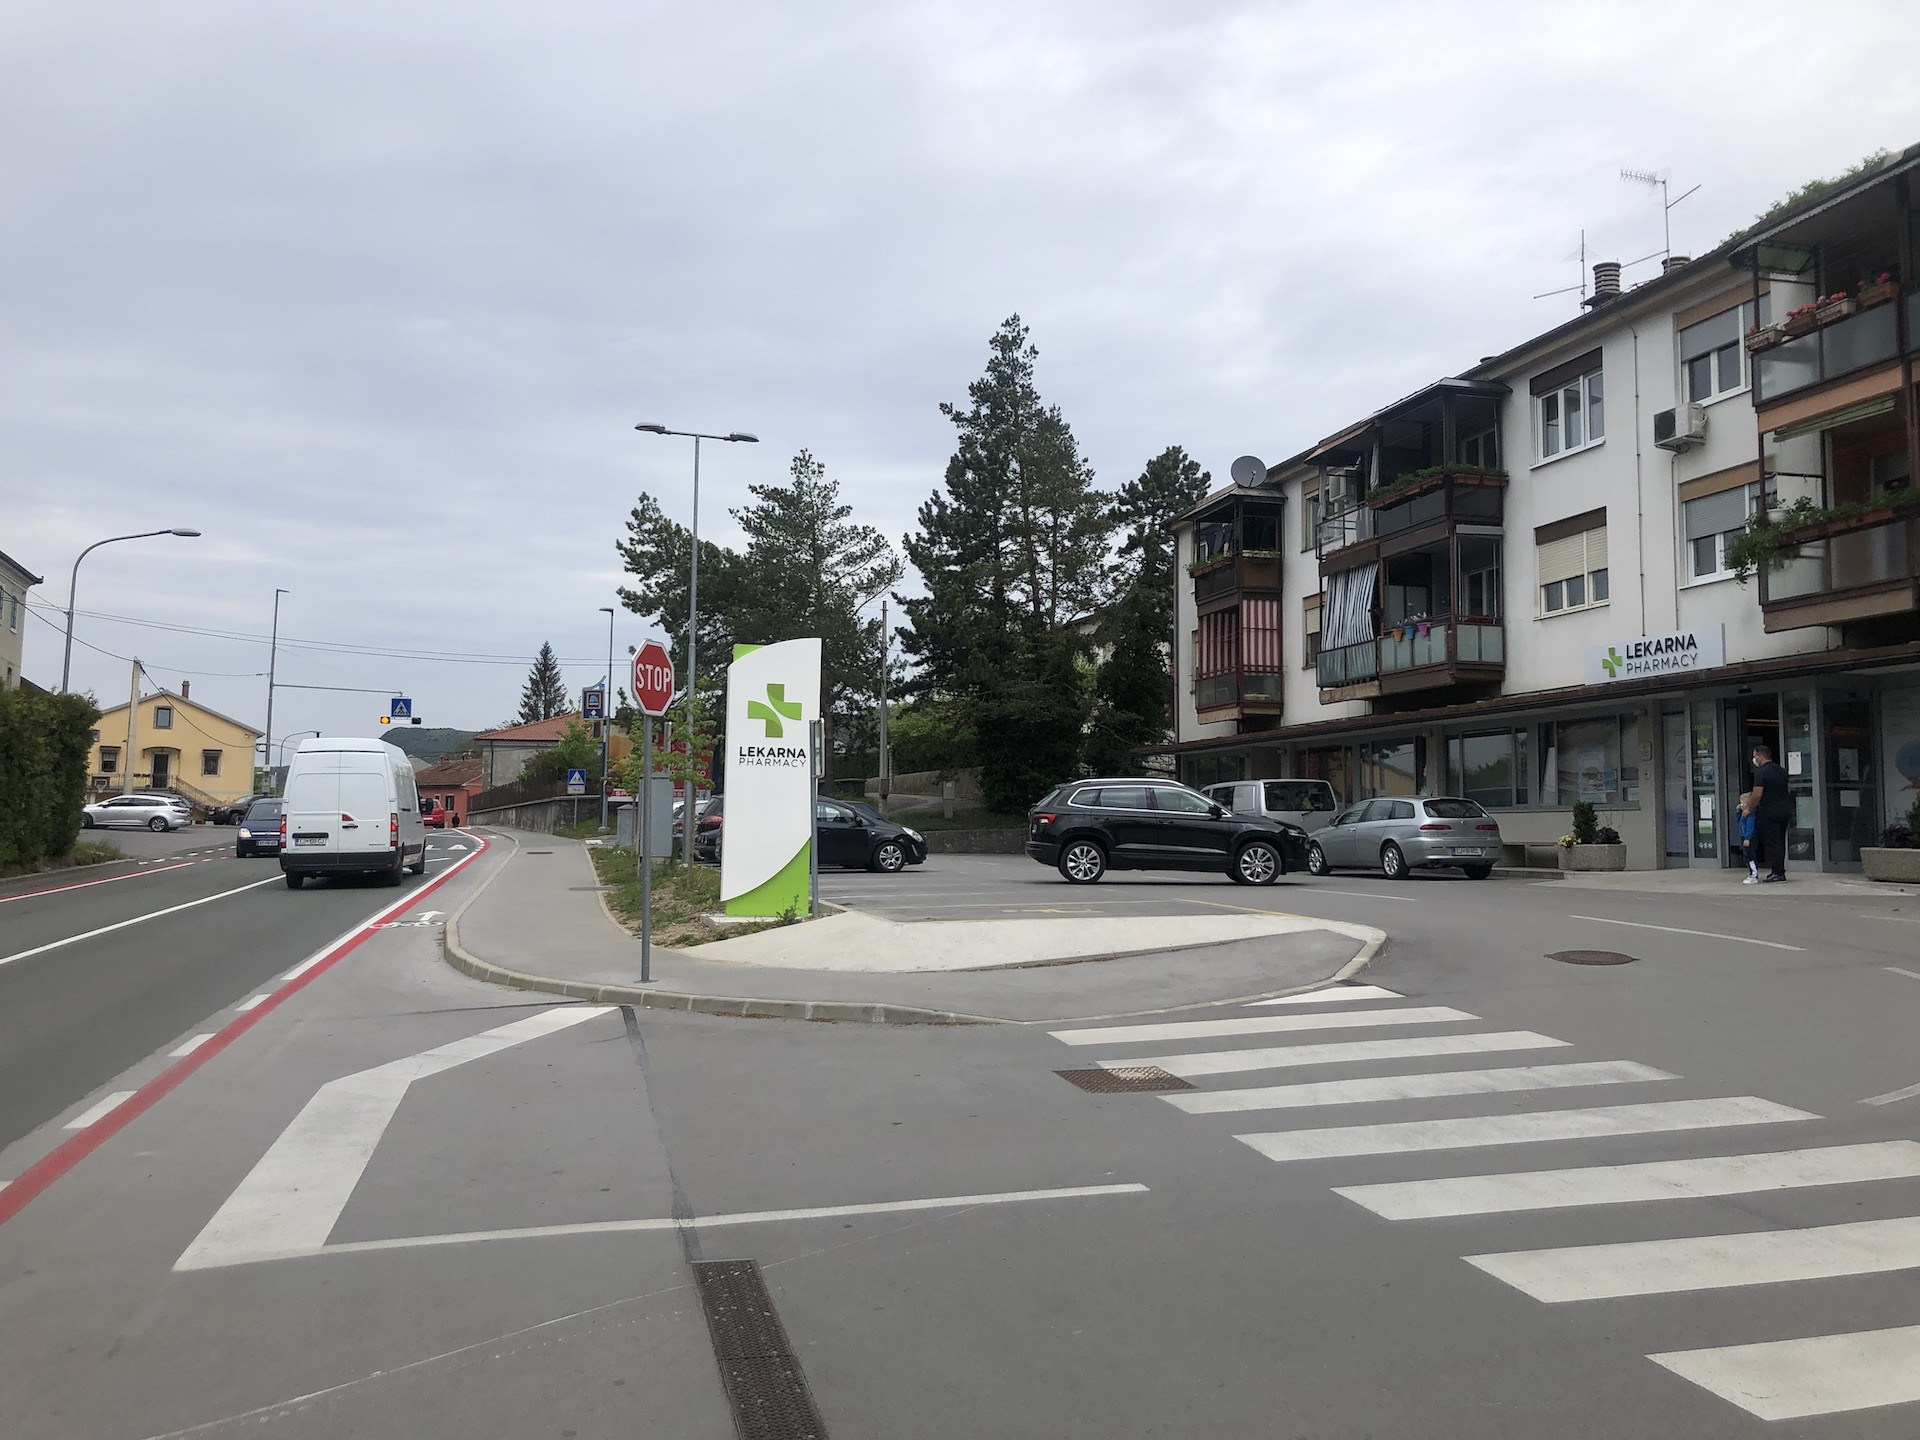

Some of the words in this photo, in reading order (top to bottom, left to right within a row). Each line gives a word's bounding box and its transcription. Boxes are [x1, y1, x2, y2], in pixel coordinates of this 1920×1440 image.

[1626, 633, 1698, 660] LEKARNA
[1626, 652, 1699, 675] PHARMACY
[636, 663, 672, 693] STOP
[738, 758, 807, 768] PHARMACY
[739, 746, 807, 759] LEKARNA
